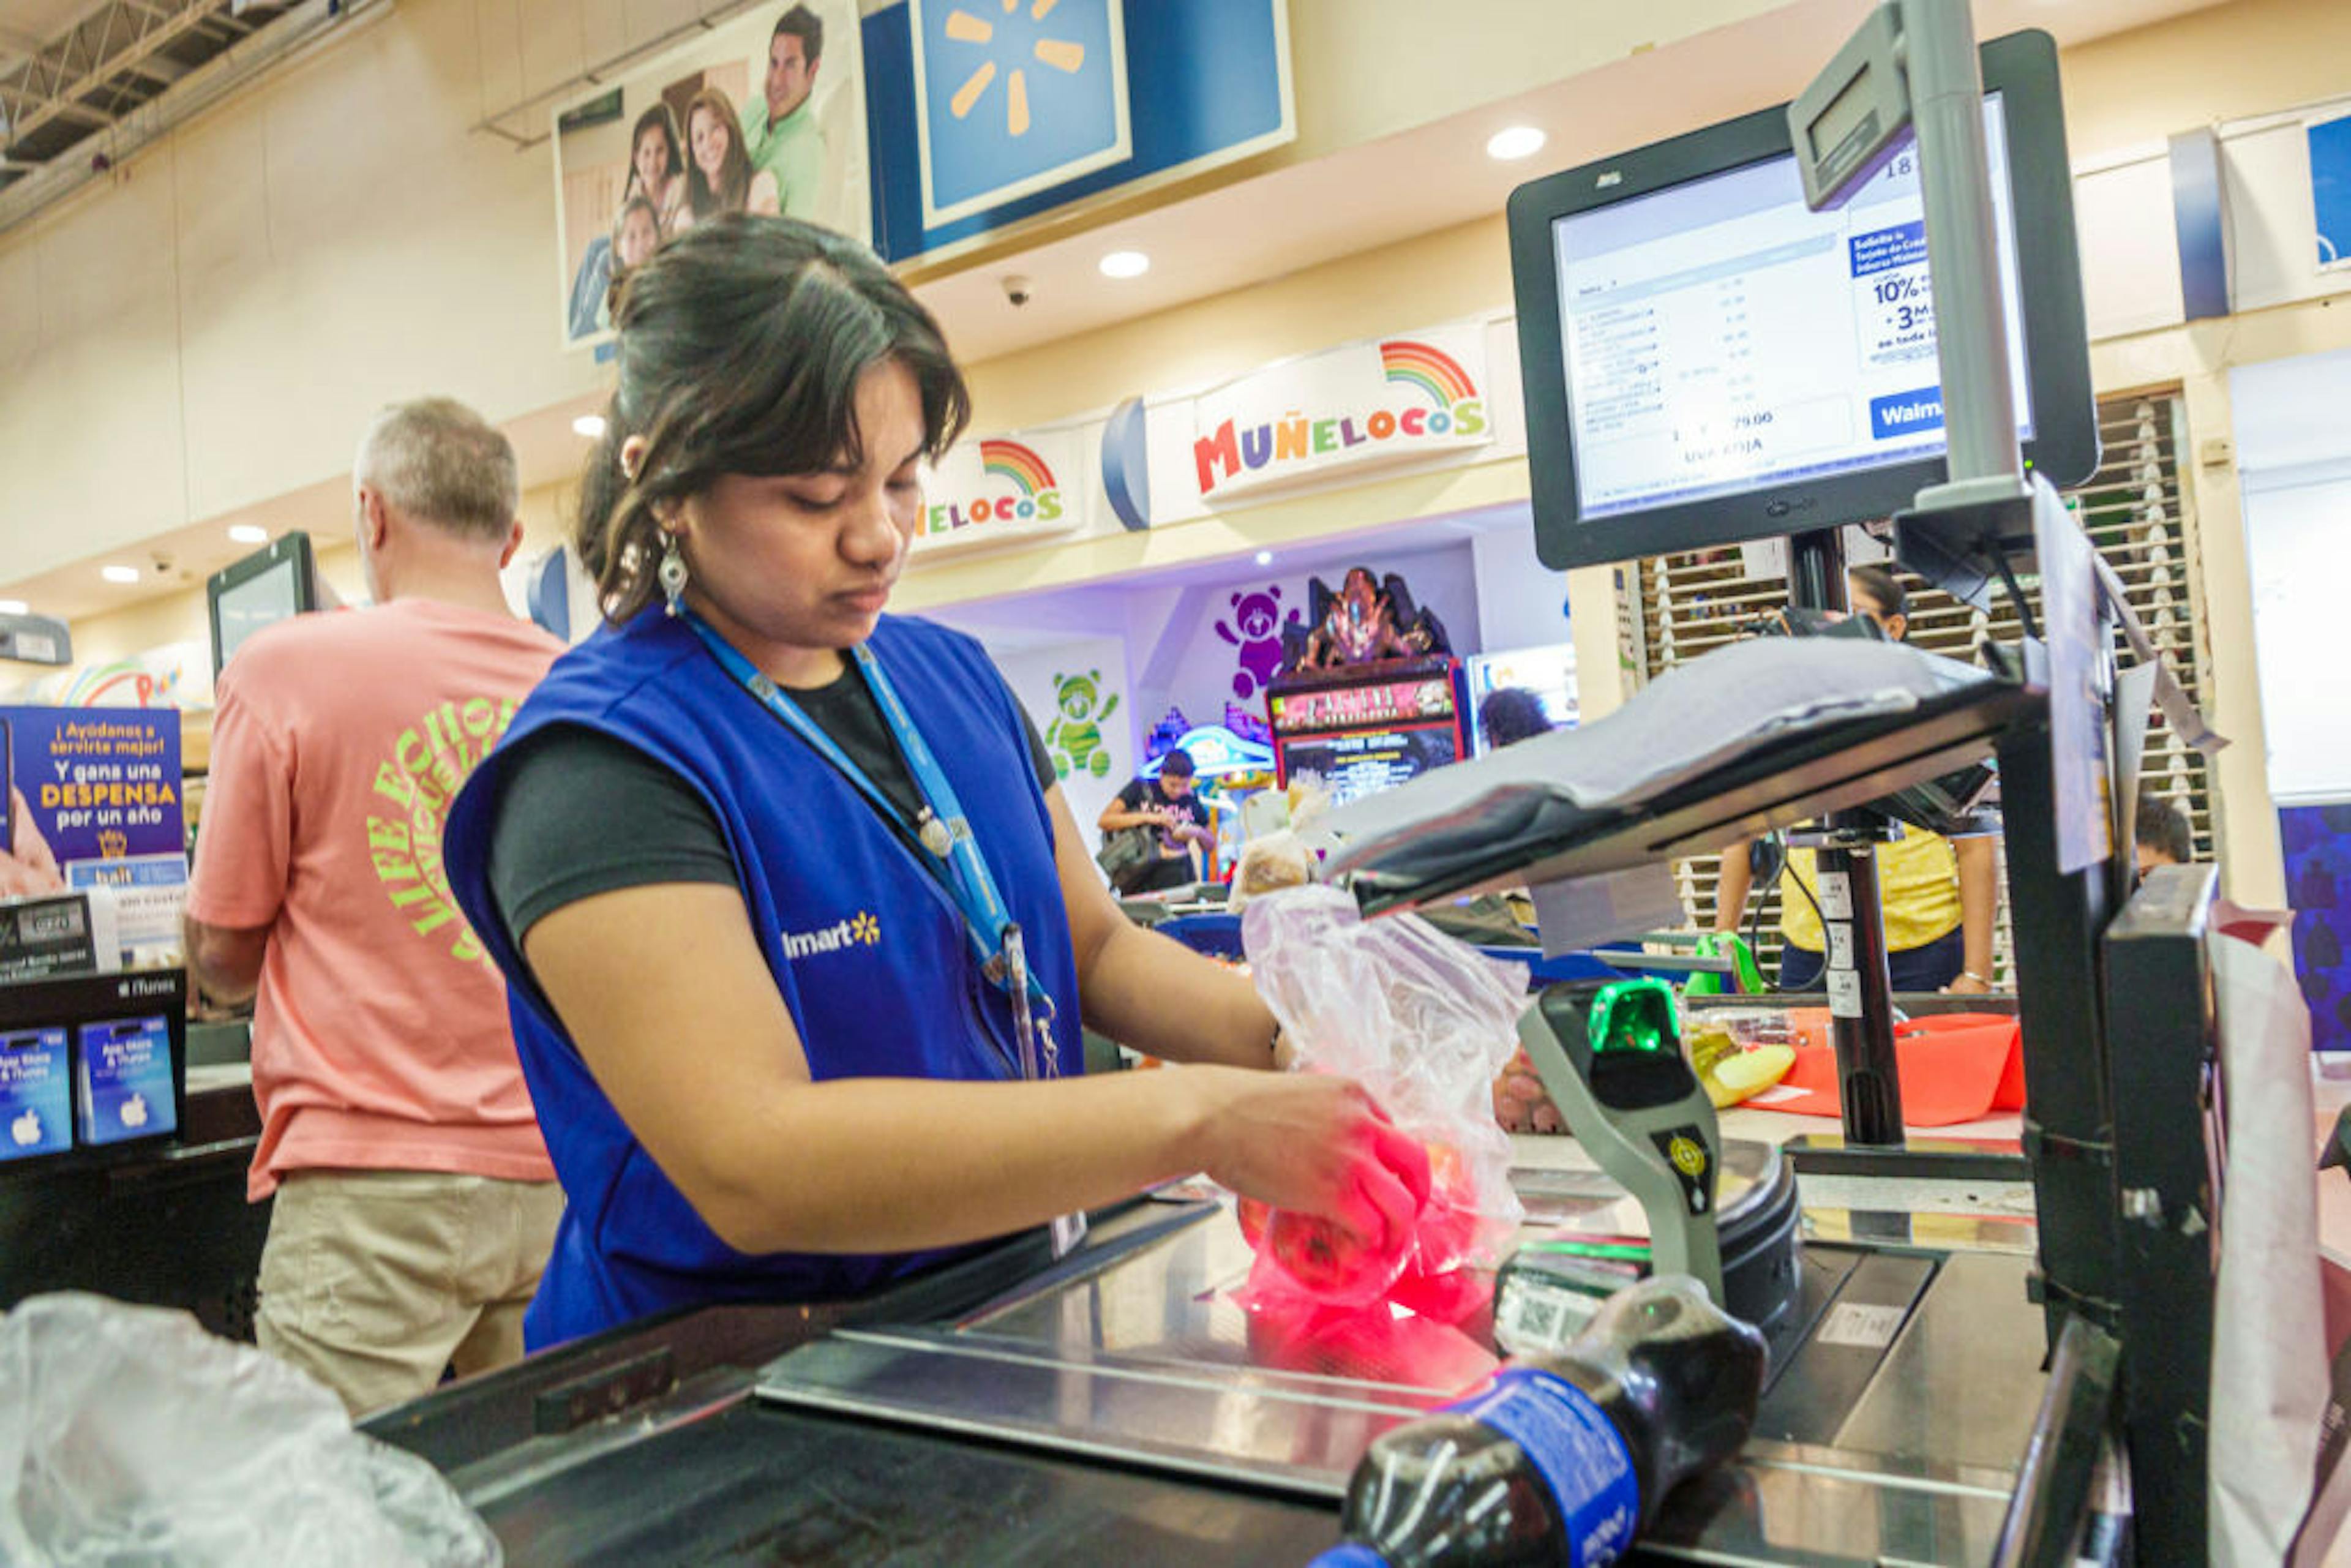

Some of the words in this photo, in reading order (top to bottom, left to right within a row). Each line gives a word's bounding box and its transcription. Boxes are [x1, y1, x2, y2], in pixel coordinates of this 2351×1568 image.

[1873, 277, 1919, 304] 10%
[1881, 401, 1943, 426] Walm
[1194, 402, 1485, 494] MUÑELOCOS
[50, 737, 111, 756] servirte
[115, 737, 164, 758] mejor!
[54, 760, 70, 781] Y
[73, 764, 121, 785] gana
[127, 763, 162, 781] una
[40, 781, 176, 809] DESPENSA
[56, 808, 92, 833] por
[97, 808, 122, 827] un
[127, 804, 162, 825] año
[132, 980, 176, 997] iTunes
